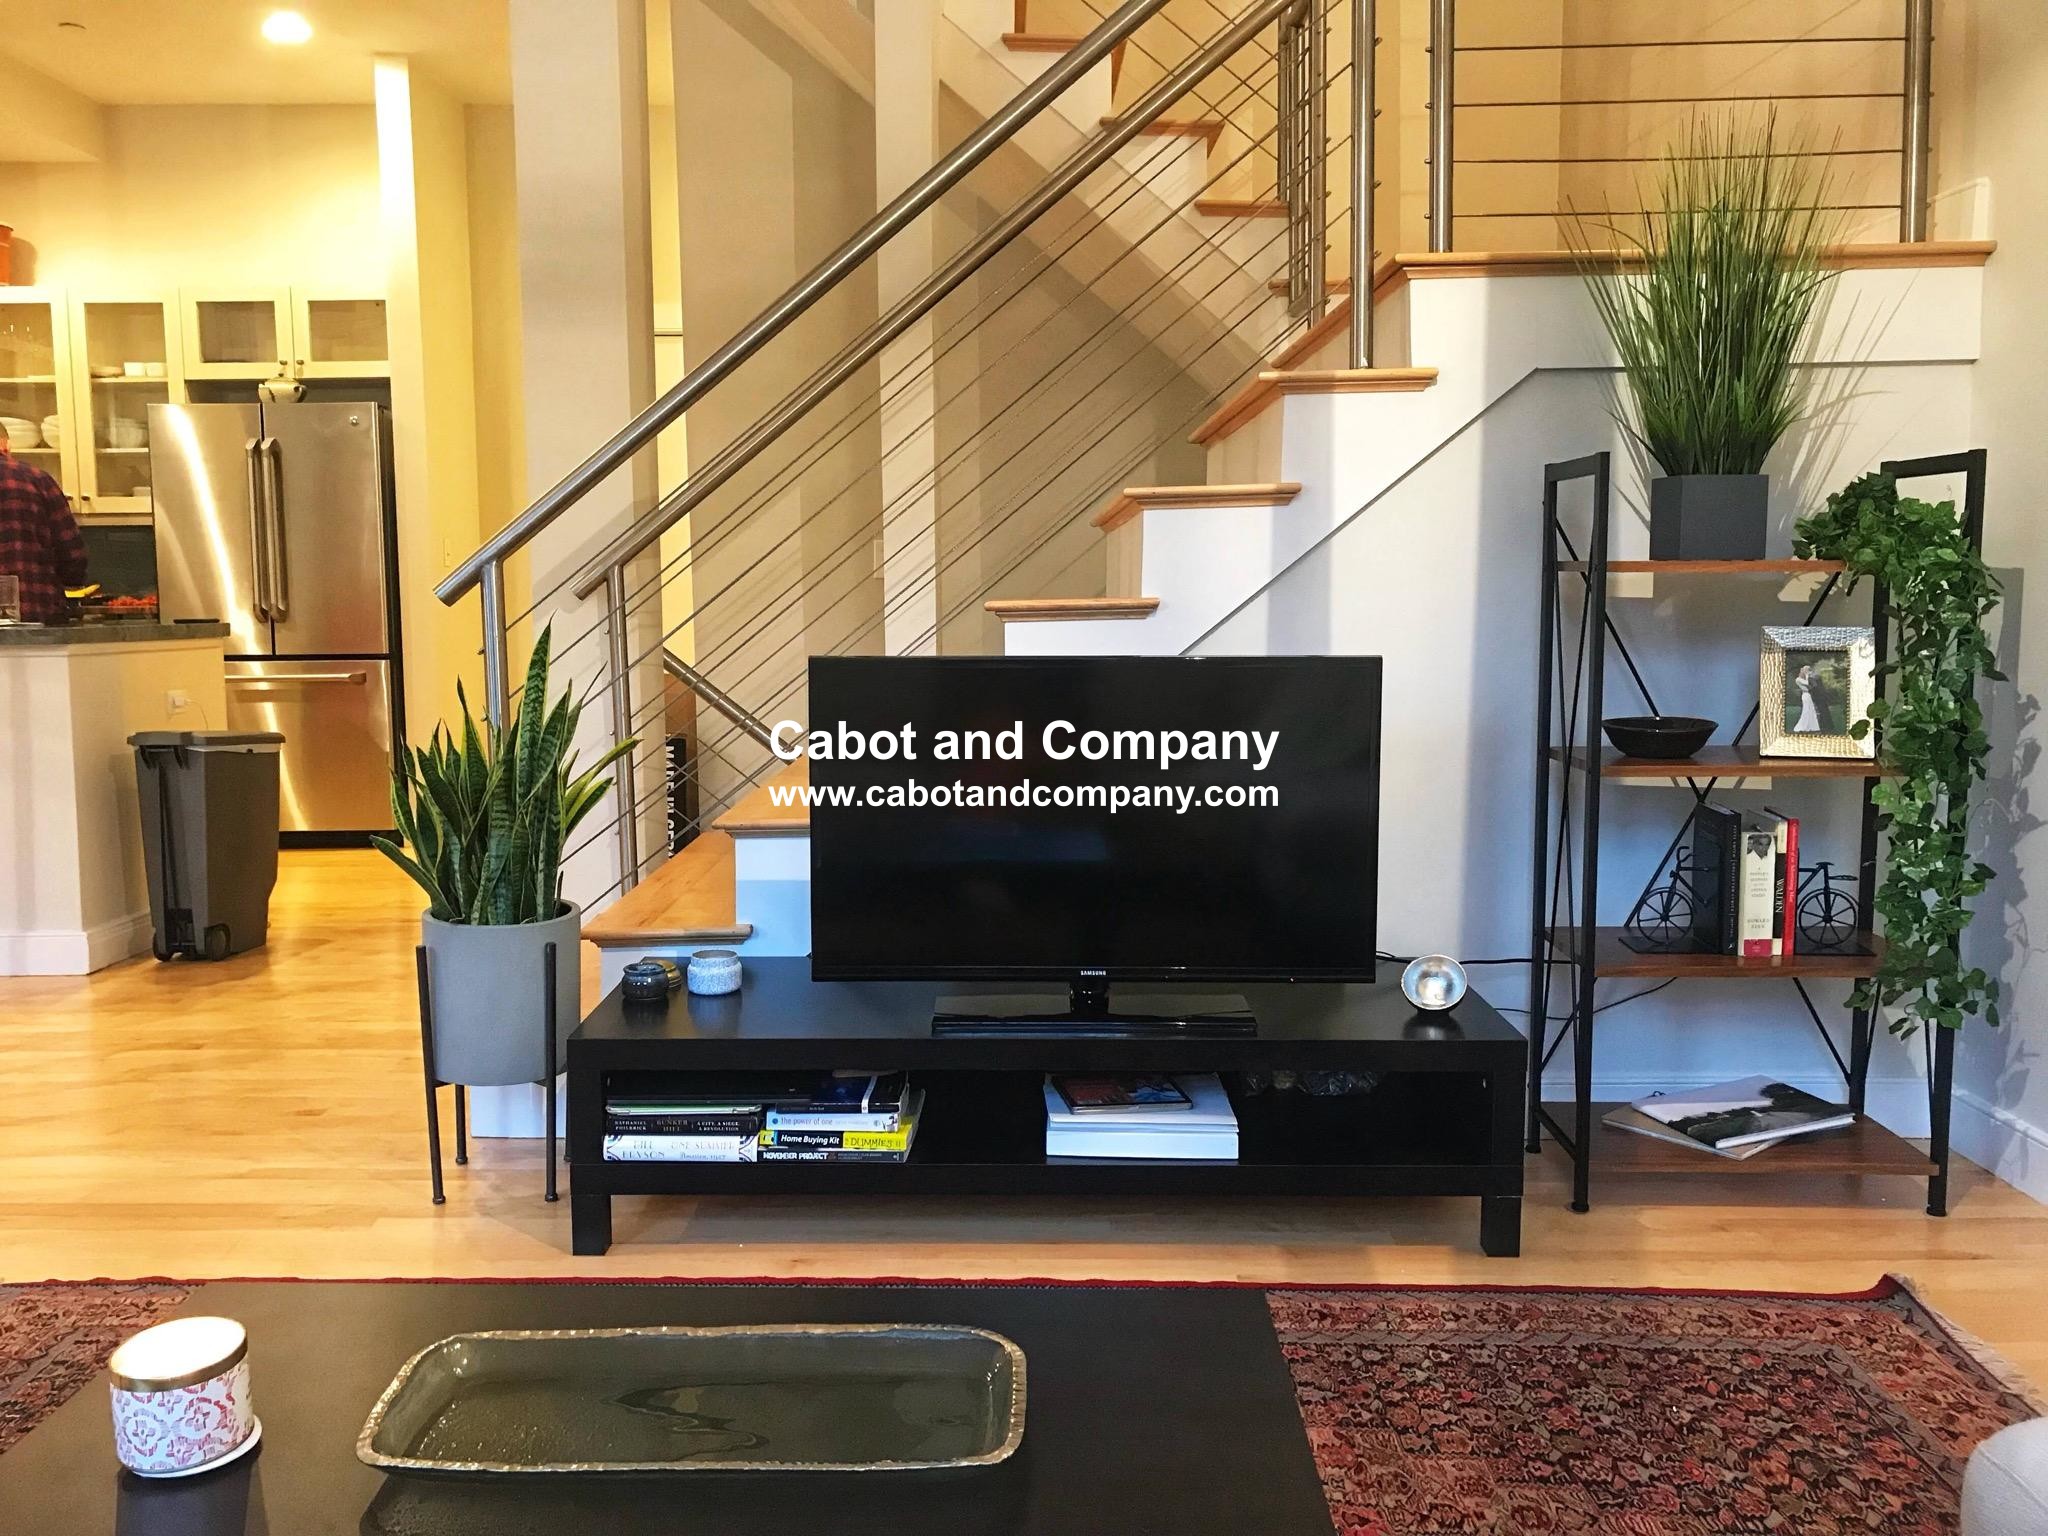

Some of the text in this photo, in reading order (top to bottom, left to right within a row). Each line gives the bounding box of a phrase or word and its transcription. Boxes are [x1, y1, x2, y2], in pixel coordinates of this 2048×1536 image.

[1775, 878, 1785, 913] WALDEN
[781, 1117, 792, 1125] the
[780, 1134, 803, 1143] Home
[803, 1135, 828, 1146] Buying
[829, 1136, 840, 1144] Kit
[850, 1137, 892, 1147] DUMMIES
[763, 1151, 798, 1160] NOVEMBER
[798, 1151, 829, 1160] PROJECT
